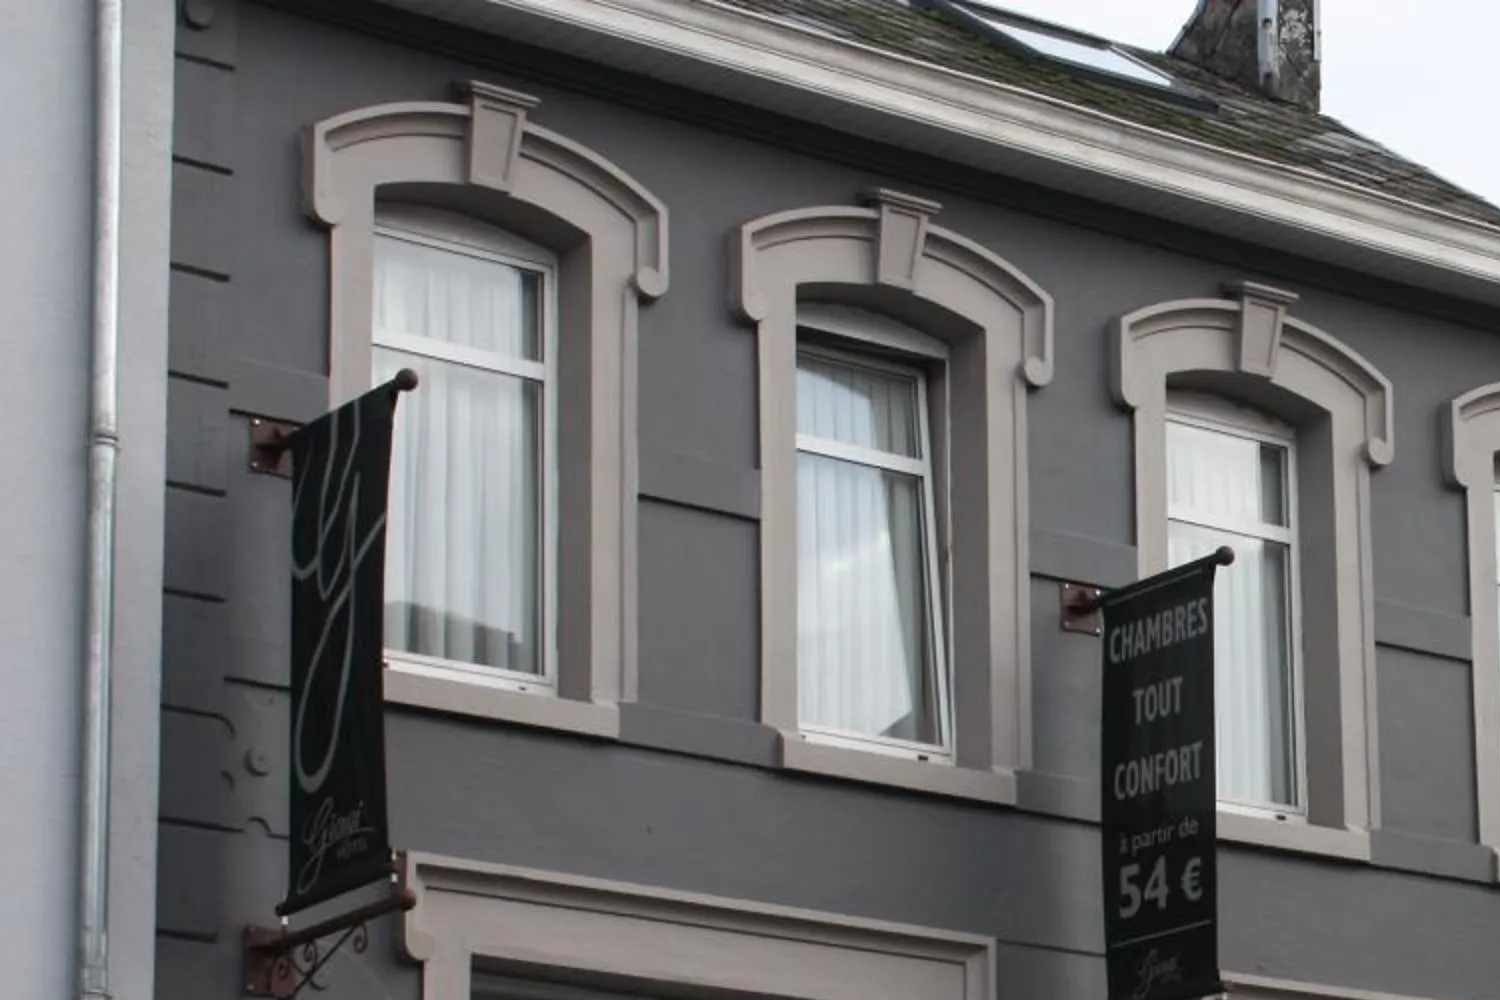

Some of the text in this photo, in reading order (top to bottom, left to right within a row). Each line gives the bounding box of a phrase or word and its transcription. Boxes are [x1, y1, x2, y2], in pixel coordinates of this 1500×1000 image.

[1110, 597, 1208, 664] CHAMBRES
[1132, 676, 1184, 726] TOUT
[1113, 740, 1204, 801] CONFORT
[1131, 824, 1176, 857] partir
[1178, 816, 1200, 838] de
[1119, 854, 1203, 919] 54 €
